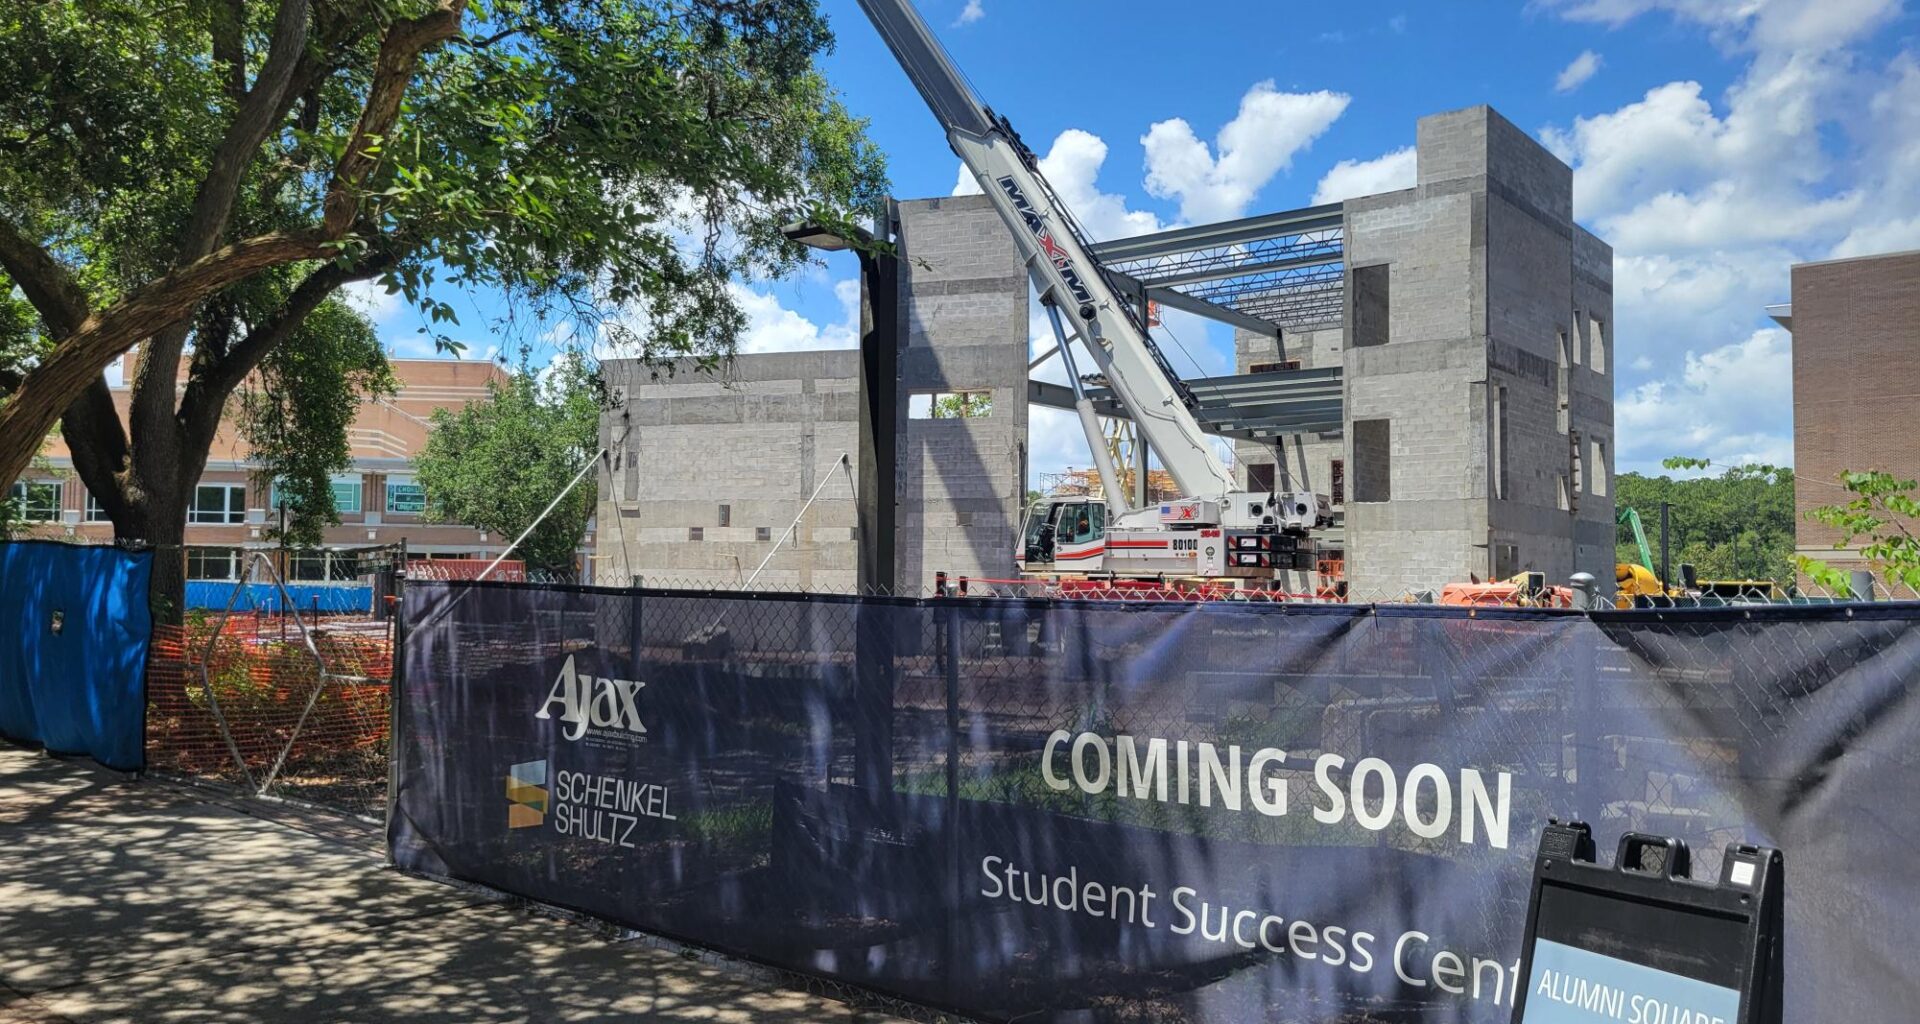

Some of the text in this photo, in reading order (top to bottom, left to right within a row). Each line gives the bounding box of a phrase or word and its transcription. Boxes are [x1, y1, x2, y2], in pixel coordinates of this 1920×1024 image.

[996, 175, 1095, 304] MAXIM
[1173, 539, 1198, 550] 80100
[534, 653, 648, 741] Ajax
[556, 769, 677, 821] SCHENKEL
[1041, 729, 1513, 849] COMING SOON
[554, 802, 638, 849] SHULTZ
[981, 855, 1521, 1008] Student Success Cent
[1536, 968, 1724, 1024] ALUMNI SQUA
